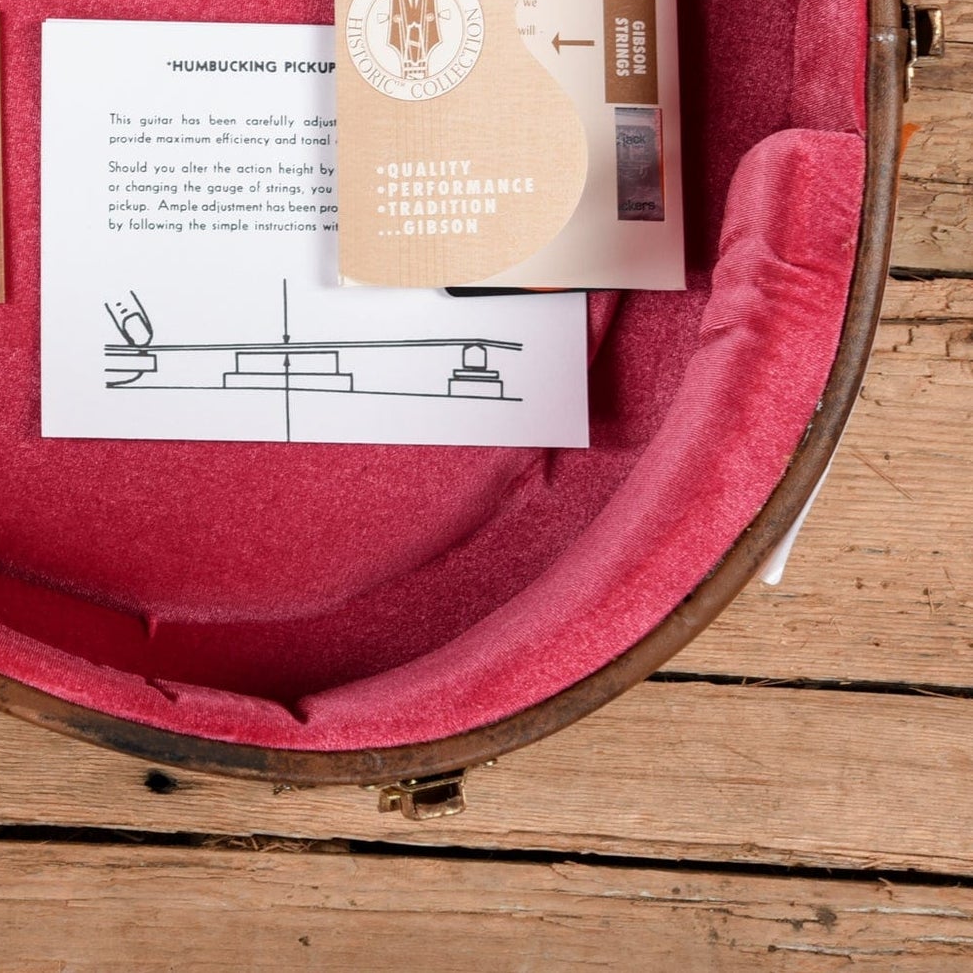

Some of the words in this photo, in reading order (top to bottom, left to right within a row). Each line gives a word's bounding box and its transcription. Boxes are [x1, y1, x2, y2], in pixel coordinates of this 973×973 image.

[348, 18, 394, 94] HISTORIC
[410, 8, 483, 99] COLLECTION
[615, 17, 630, 77] STRINGS
[632, 20, 646, 75] GIBSON
[109, 132, 152, 145] provide
[155, 132, 211, 144] maximum
[215, 132, 271, 147] efficiency
[274, 132, 297, 145] and
[300, 133, 331, 145] tonal
[108, 161, 148, 173] Should
[153, 165, 176, 175] you
[181, 162, 208, 174] alter
[213, 162, 231, 174] the
[236, 163, 272, 174] action
[278, 162, 314, 177] height
[319, 162, 335, 177] by
[387, 160, 472, 179] QUALITY
[108, 184, 120, 192] or
[125, 180, 178, 195] changing
[183, 180, 202, 193] the
[206, 184, 244, 195] gauge
[248, 181, 261, 193] of
[265, 182, 305, 195] strings,
[310, 185, 333, 195] you
[387, 178, 535, 197] PERFORMANCE
[387, 198, 497, 216] TRADITION
